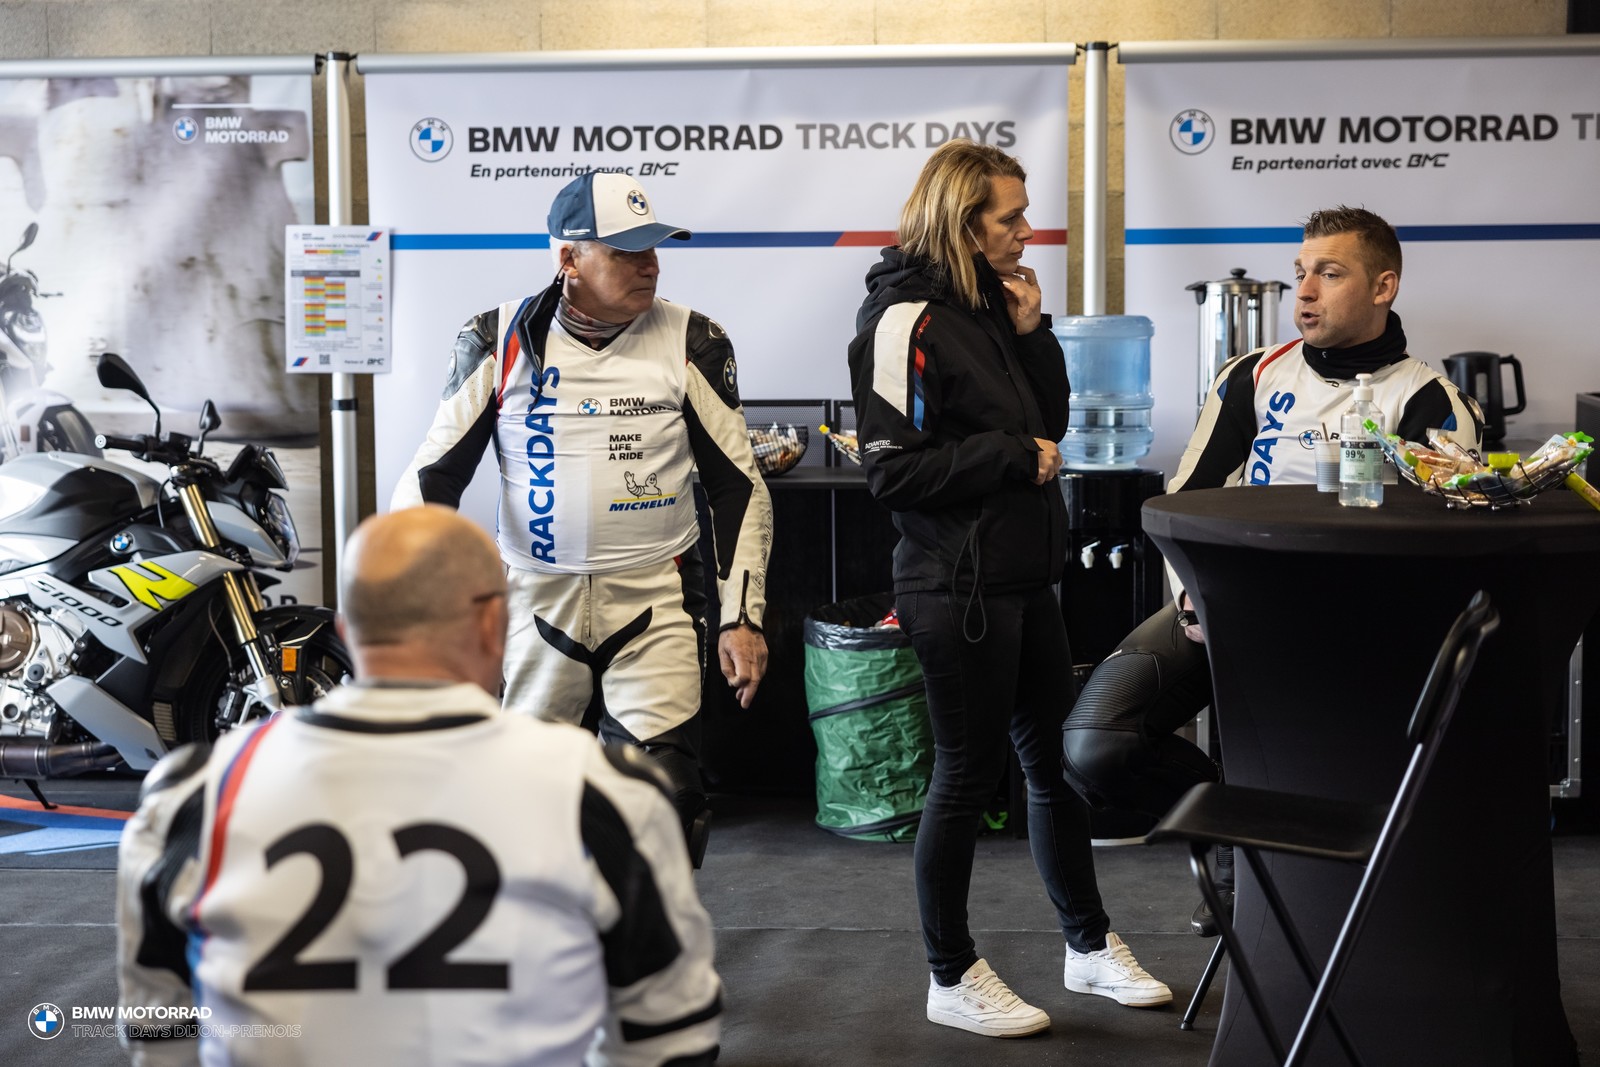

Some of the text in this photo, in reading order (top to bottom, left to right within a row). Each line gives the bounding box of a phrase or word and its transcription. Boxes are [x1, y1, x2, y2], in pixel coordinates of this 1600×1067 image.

[205, 116, 242, 129] BMW
[1230, 117, 1326, 145] BMW
[1339, 114, 1559, 144] MOTORRAD
[205, 130, 289, 143] MOTORRAD
[468, 121, 1016, 153] BMW MOTORRAD TRACK DAYS
[1231, 153, 1450, 174] En partenariat avec BMC
[470, 164, 491, 178] En
[495, 162, 591, 181] partenariat
[639, 162, 679, 176] BMC
[609, 397, 645, 407] BMW
[609, 433, 642, 442] MAKE
[609, 443, 632, 452] LIFE
[1345, 449, 1366, 459] 99%
[608, 451, 644, 461] A RIDE
[609, 496, 677, 512] MICHELIN
[242, 821, 511, 993] 22
